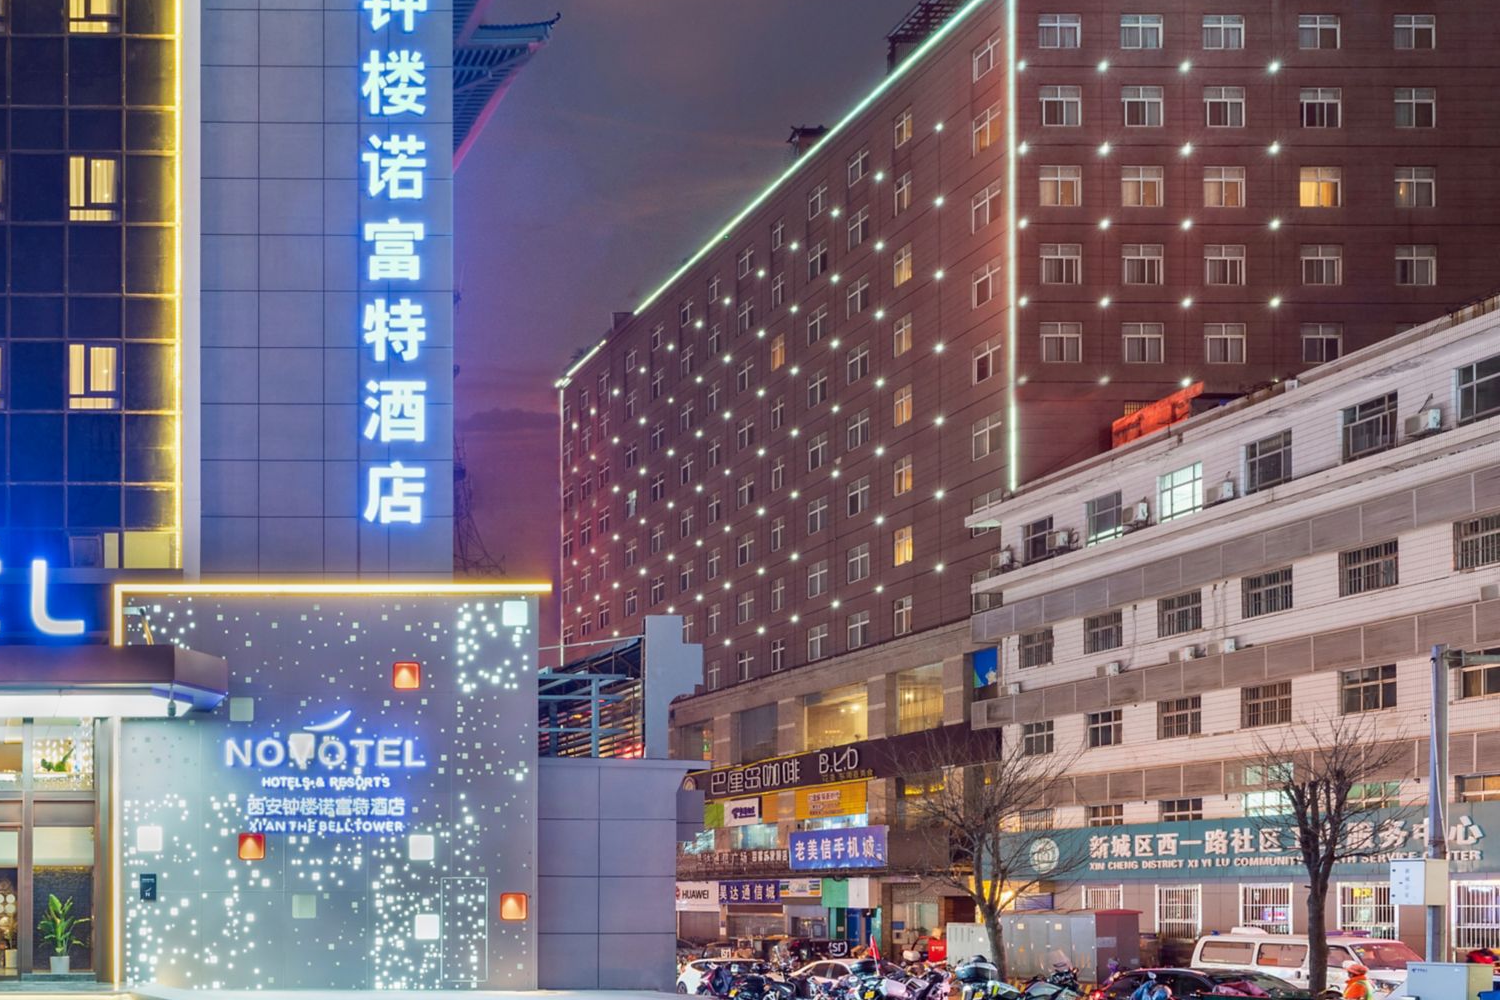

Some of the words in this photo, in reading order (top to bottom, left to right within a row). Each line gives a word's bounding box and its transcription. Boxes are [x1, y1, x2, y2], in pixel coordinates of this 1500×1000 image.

[225, 738, 426, 768] NOVOTEL
[262, 776, 311, 788] HOTELS
[329, 776, 390, 788] RESORTS
[711, 758, 800, 795] 巴厘岛咖啡
[248, 797, 405, 816] 西安钟楼诺富特酒店
[288, 820, 316, 832] THE
[354, 820, 403, 832] TOWER
[1089, 861, 1105, 871] XIN
[1107, 861, 1139, 871] CHENG
[1141, 859, 1185, 869] DISTRICT
[1187, 859, 1199, 868] XI
[1202, 858, 1212, 868] YI
[1216, 858, 1229, 867] LU
[1422, 850, 1481, 861] CTER
[682, 890, 709, 900] HUAWEI
